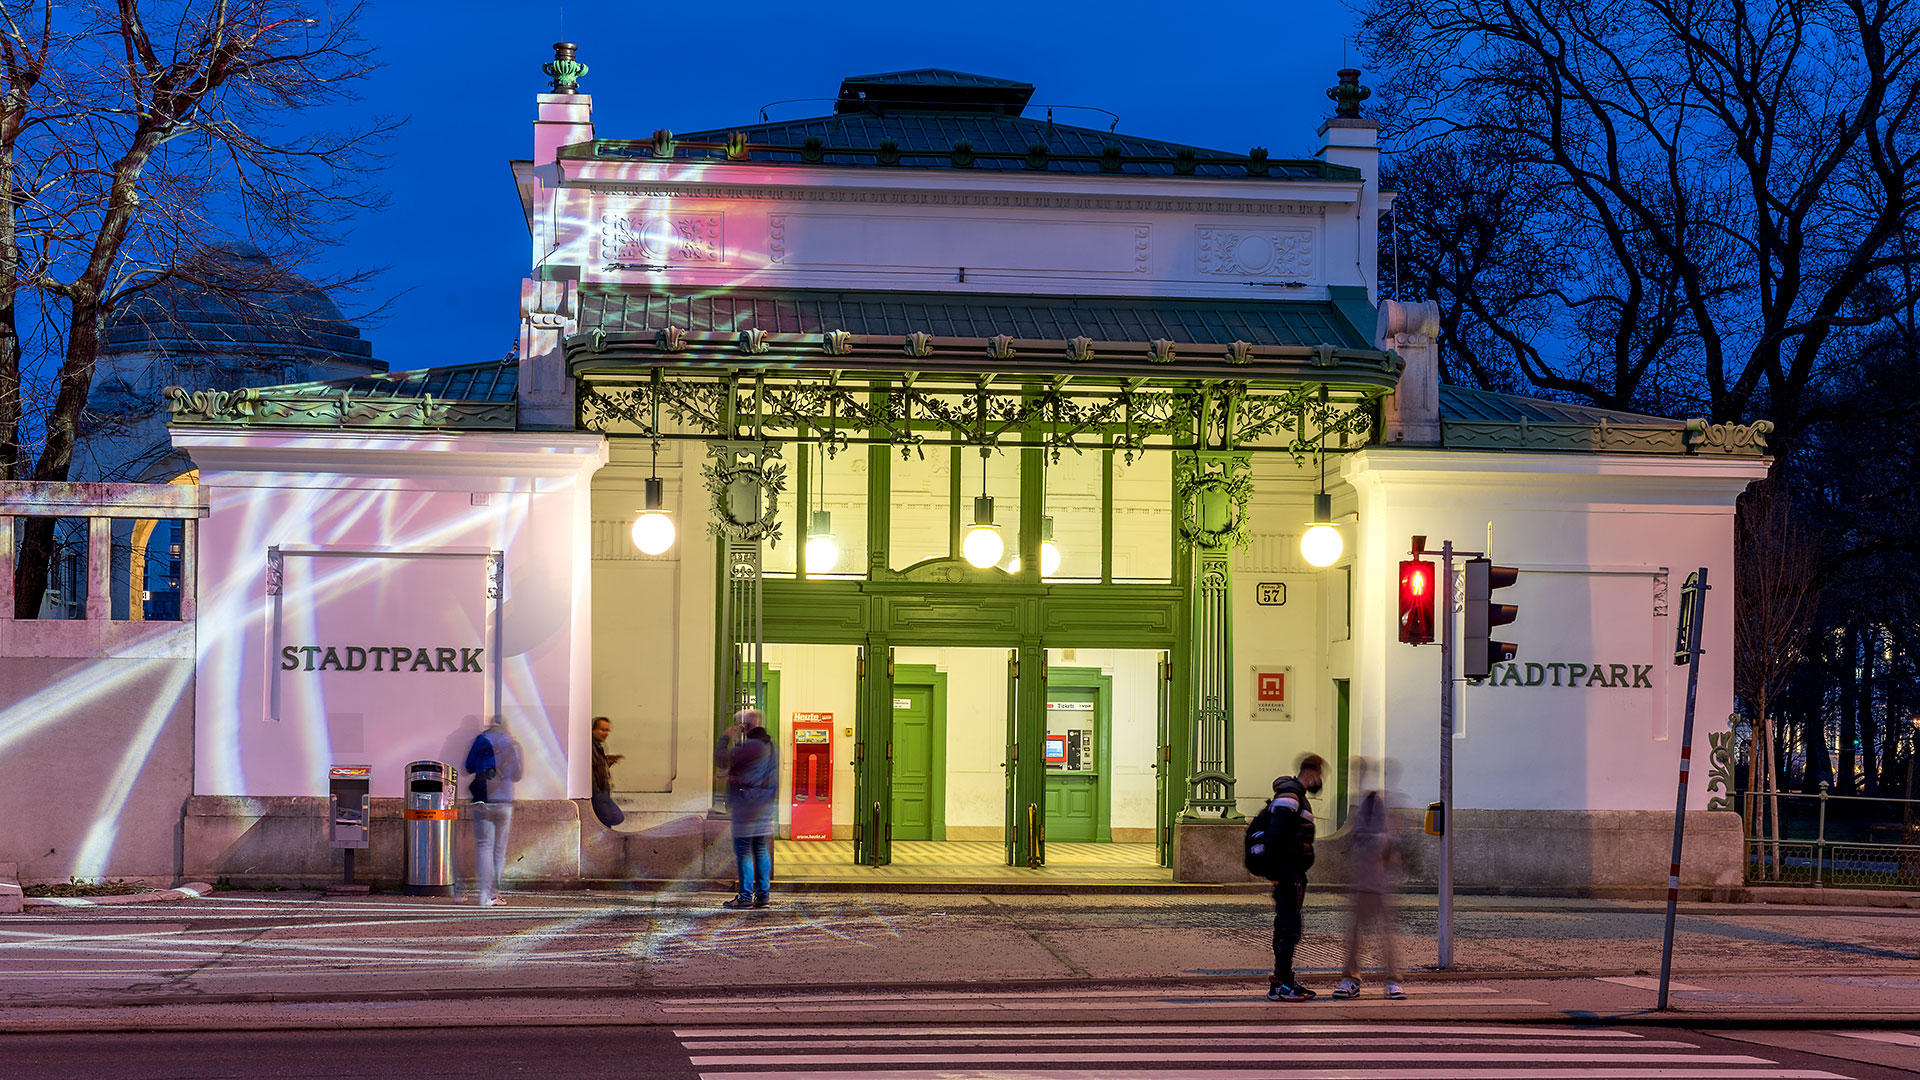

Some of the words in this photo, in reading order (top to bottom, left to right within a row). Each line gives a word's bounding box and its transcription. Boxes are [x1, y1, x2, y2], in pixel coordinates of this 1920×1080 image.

[1263, 590, 1280, 602] 57
[281, 645, 484, 673] STADTPARK
[1467, 662, 1654, 689] TADTPARK
[794, 712, 819, 721] Heute
